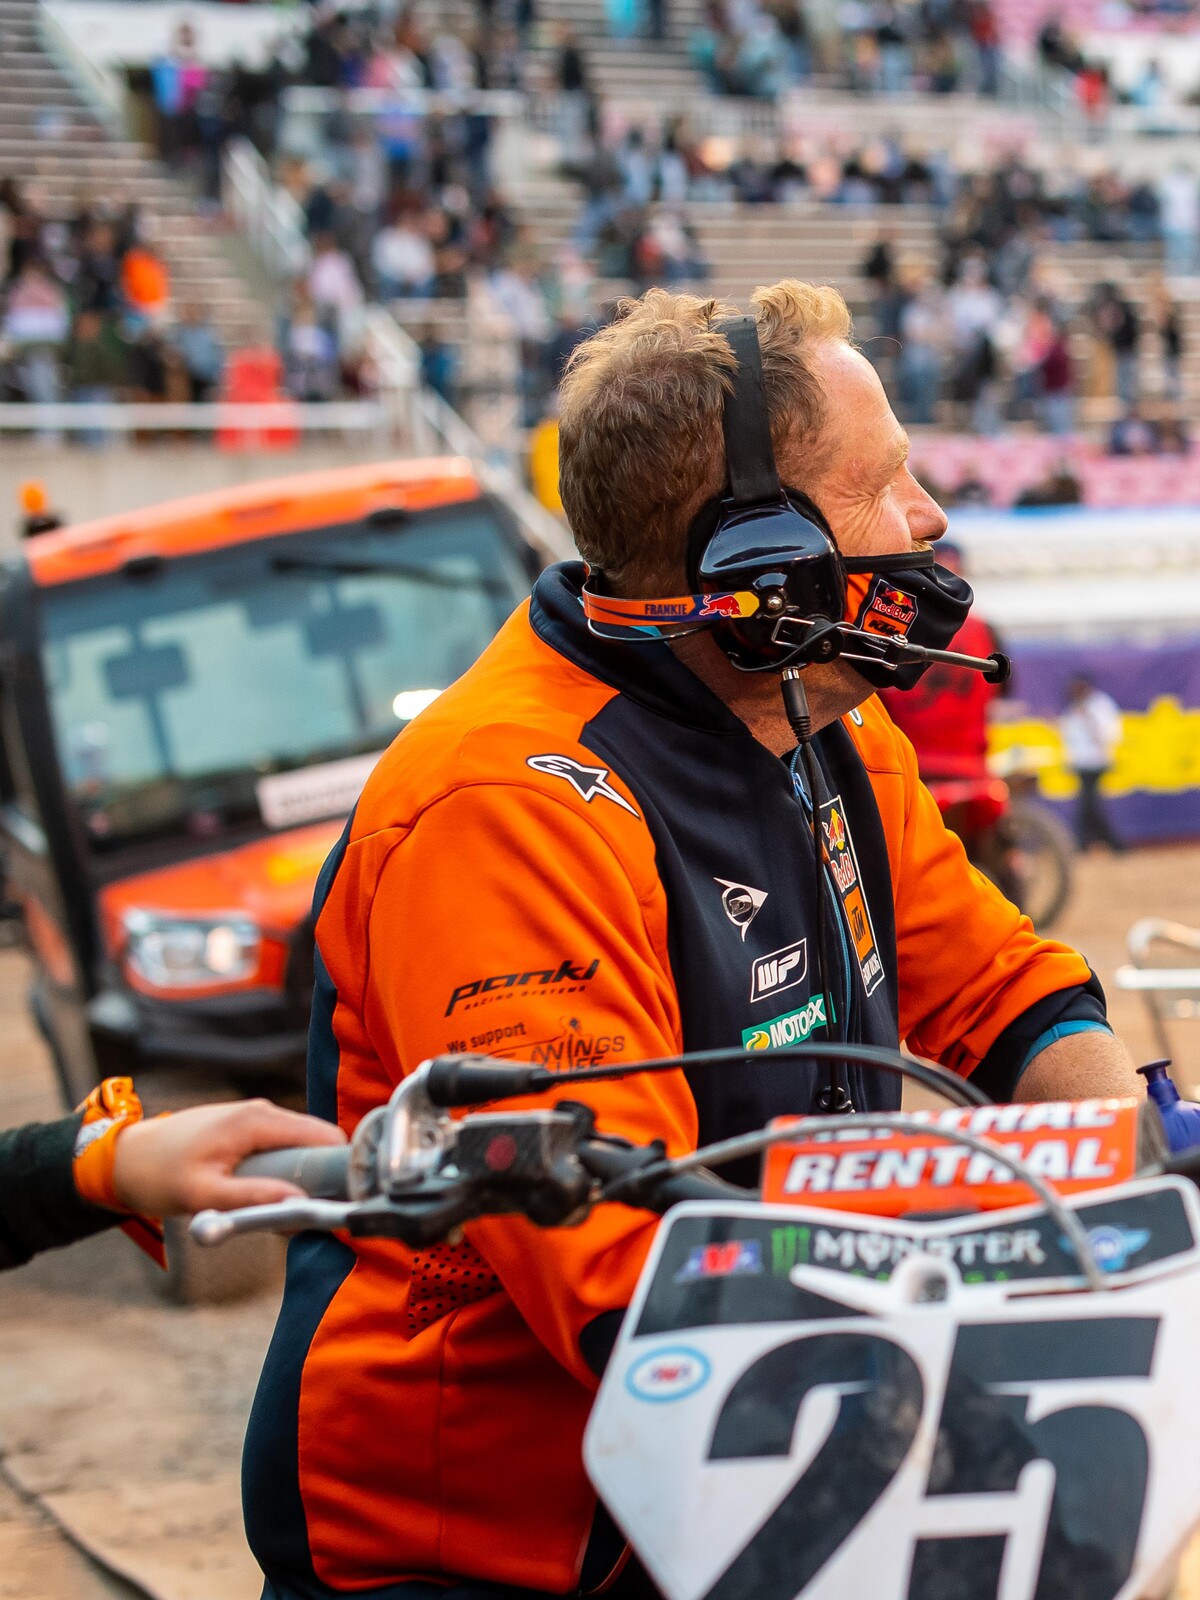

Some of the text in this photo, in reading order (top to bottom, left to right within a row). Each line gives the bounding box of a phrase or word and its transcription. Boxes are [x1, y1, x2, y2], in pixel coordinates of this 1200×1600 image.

[645, 604, 688, 615] FRANKIE
[758, 950, 801, 992] WP
[469, 1022, 527, 1050] support
[783, 1137, 1115, 1195] RENTHAL
[702, 1316, 1162, 1600] 25
